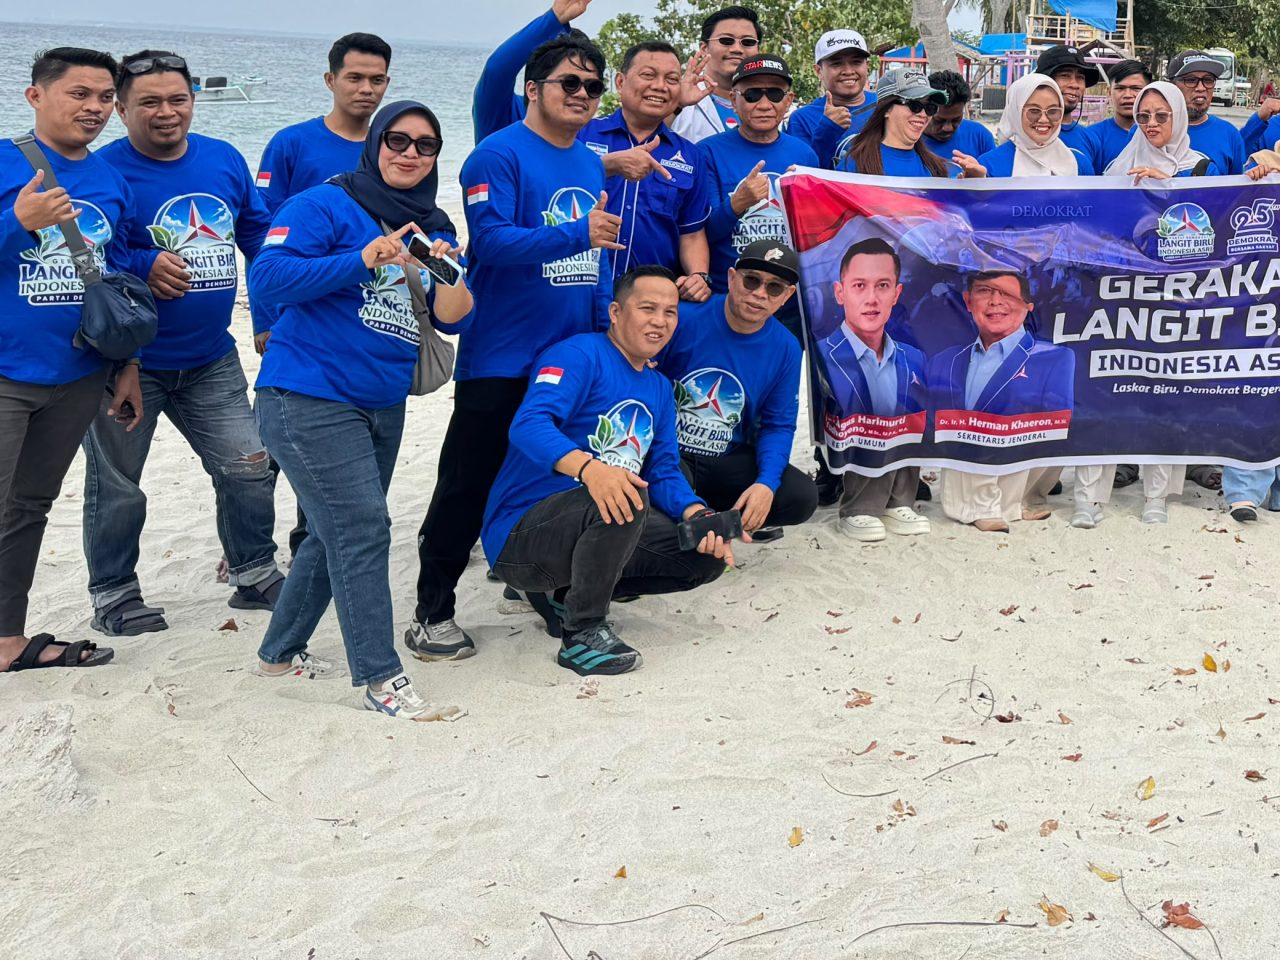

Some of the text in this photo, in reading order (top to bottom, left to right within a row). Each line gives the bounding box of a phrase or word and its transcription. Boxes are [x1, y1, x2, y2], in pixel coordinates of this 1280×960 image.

[1012, 205, 1093, 217] DEMOKRAT
[1159, 239, 1193, 248] LANGIT
[1194, 238, 1213, 246] BIRU
[1228, 237, 1277, 246] DEMOKRAT
[20, 265, 80, 282] LANGI
[21, 281, 84, 294] INDONES
[369, 320, 398, 333] PARTAI
[1053, 307, 1234, 344] LANGIT
[1098, 353, 1240, 375] INDONESIA
[1113, 383, 1150, 393] Laskar
[1153, 385, 1179, 395] Biru,
[1183, 385, 1240, 395] Demokrat
[858, 415, 906, 428] Harimurti
[968, 416, 1008, 431] Herman
[1011, 418, 1053, 430] Khaeron,
[675, 419, 709, 438] NGIT
[858, 437, 886, 448] UMUM
[957, 431, 1047, 445] SEKRETARIS JENDERAL
